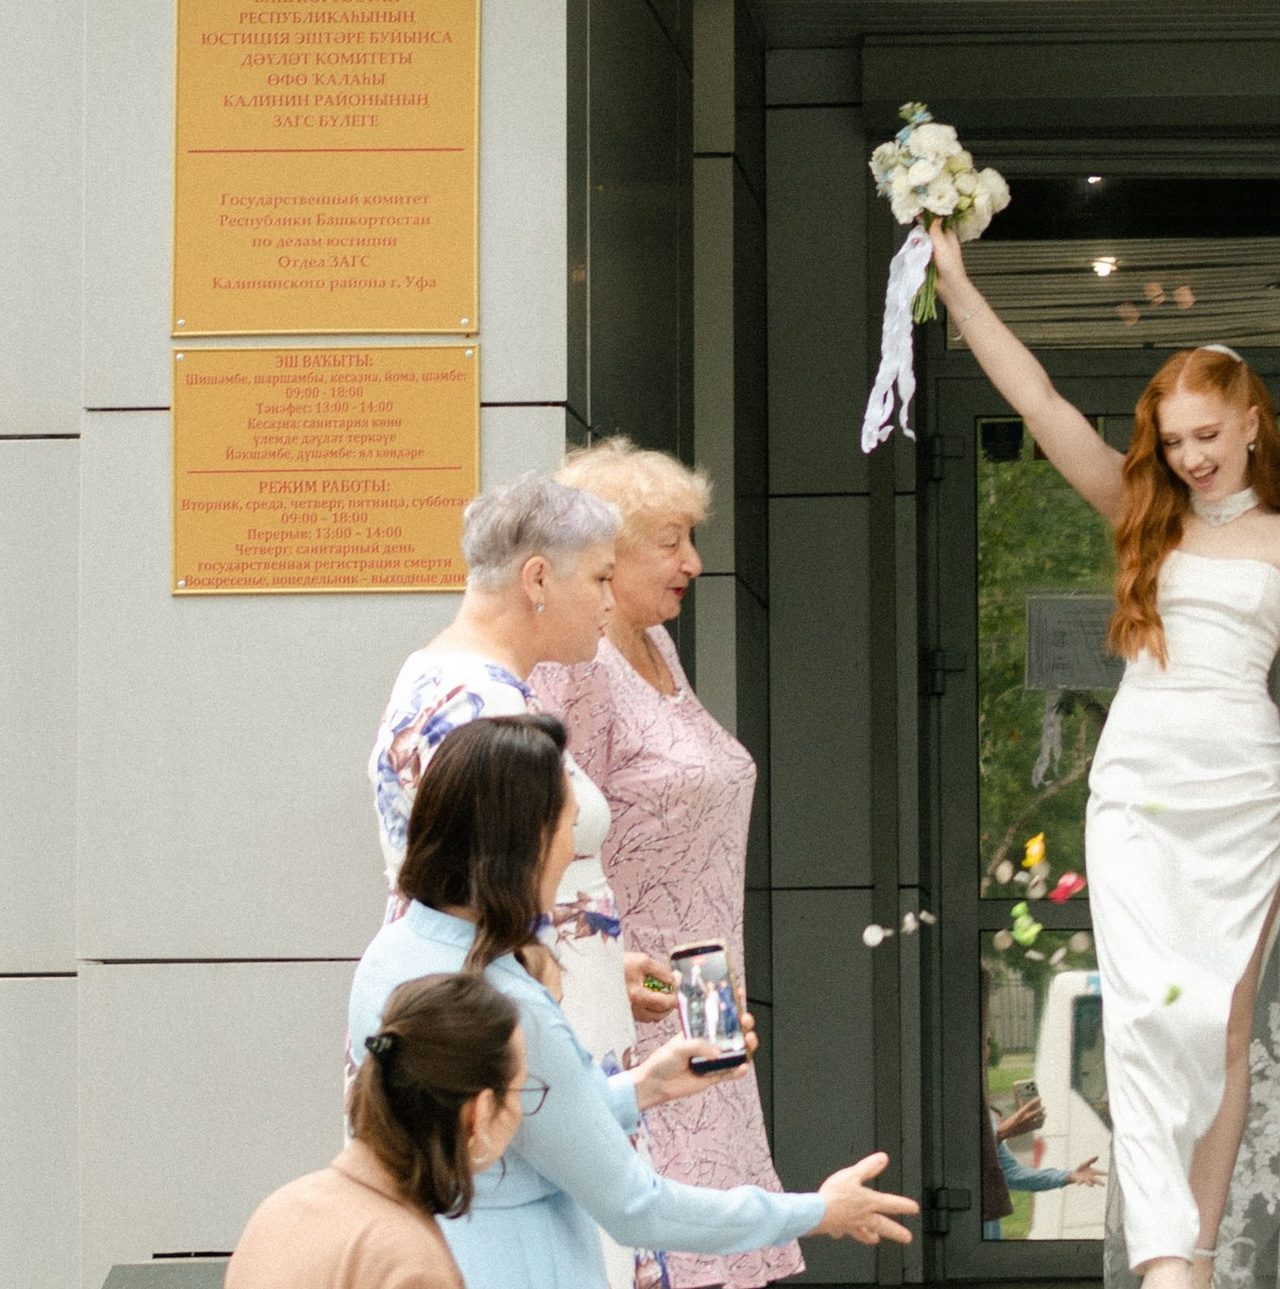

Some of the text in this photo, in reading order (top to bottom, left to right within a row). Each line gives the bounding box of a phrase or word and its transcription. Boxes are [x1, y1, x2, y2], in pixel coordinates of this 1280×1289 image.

[202, 32, 290, 45] ЮСТИЦИЯ
[369, 30, 453, 44] БУЙЫНСА
[315, 52, 413, 65] КОМИТЕТЫ
[223, 94, 309, 107] КАЛИНИН
[273, 115, 315, 128] ЗАГС
[221, 193, 430, 209] Государственный комитет
[219, 213, 431, 230] Республики Башкортостан
[252, 237, 398, 249] по делам юстиции
[278, 254, 370, 268] Отдел ЗАГС
[212, 275, 437, 292] Калининского района г. Уфа
[276, 355, 298, 368] ЭШ
[285, 387, 319, 398] 09:00
[330, 386, 364, 398] 18:00
[316, 401, 349, 413] 13:00
[359, 401, 393, 412] 14:00
[259, 479, 390, 493] РЕЖИМ РАБОТЫ:
[181, 499, 243, 512] Вторник,
[246, 499, 287, 512] среда,
[291, 499, 345, 511] четверг,
[349, 498, 408, 509] пятница,
[281, 513, 318, 524] 09:00
[332, 512, 368, 523] 18:00
[247, 528, 312, 542] Перерыв:
[316, 527, 351, 539] 13:00
[366, 526, 402, 538] 14:00
[235, 542, 415, 557] Четверг: санитарный день
[198, 557, 452, 573] государственная регистрация смерти
[184, 574, 269, 588] Воскресенье,
[272, 574, 358, 586] понедельник
[371, 573, 437, 585] выходные
